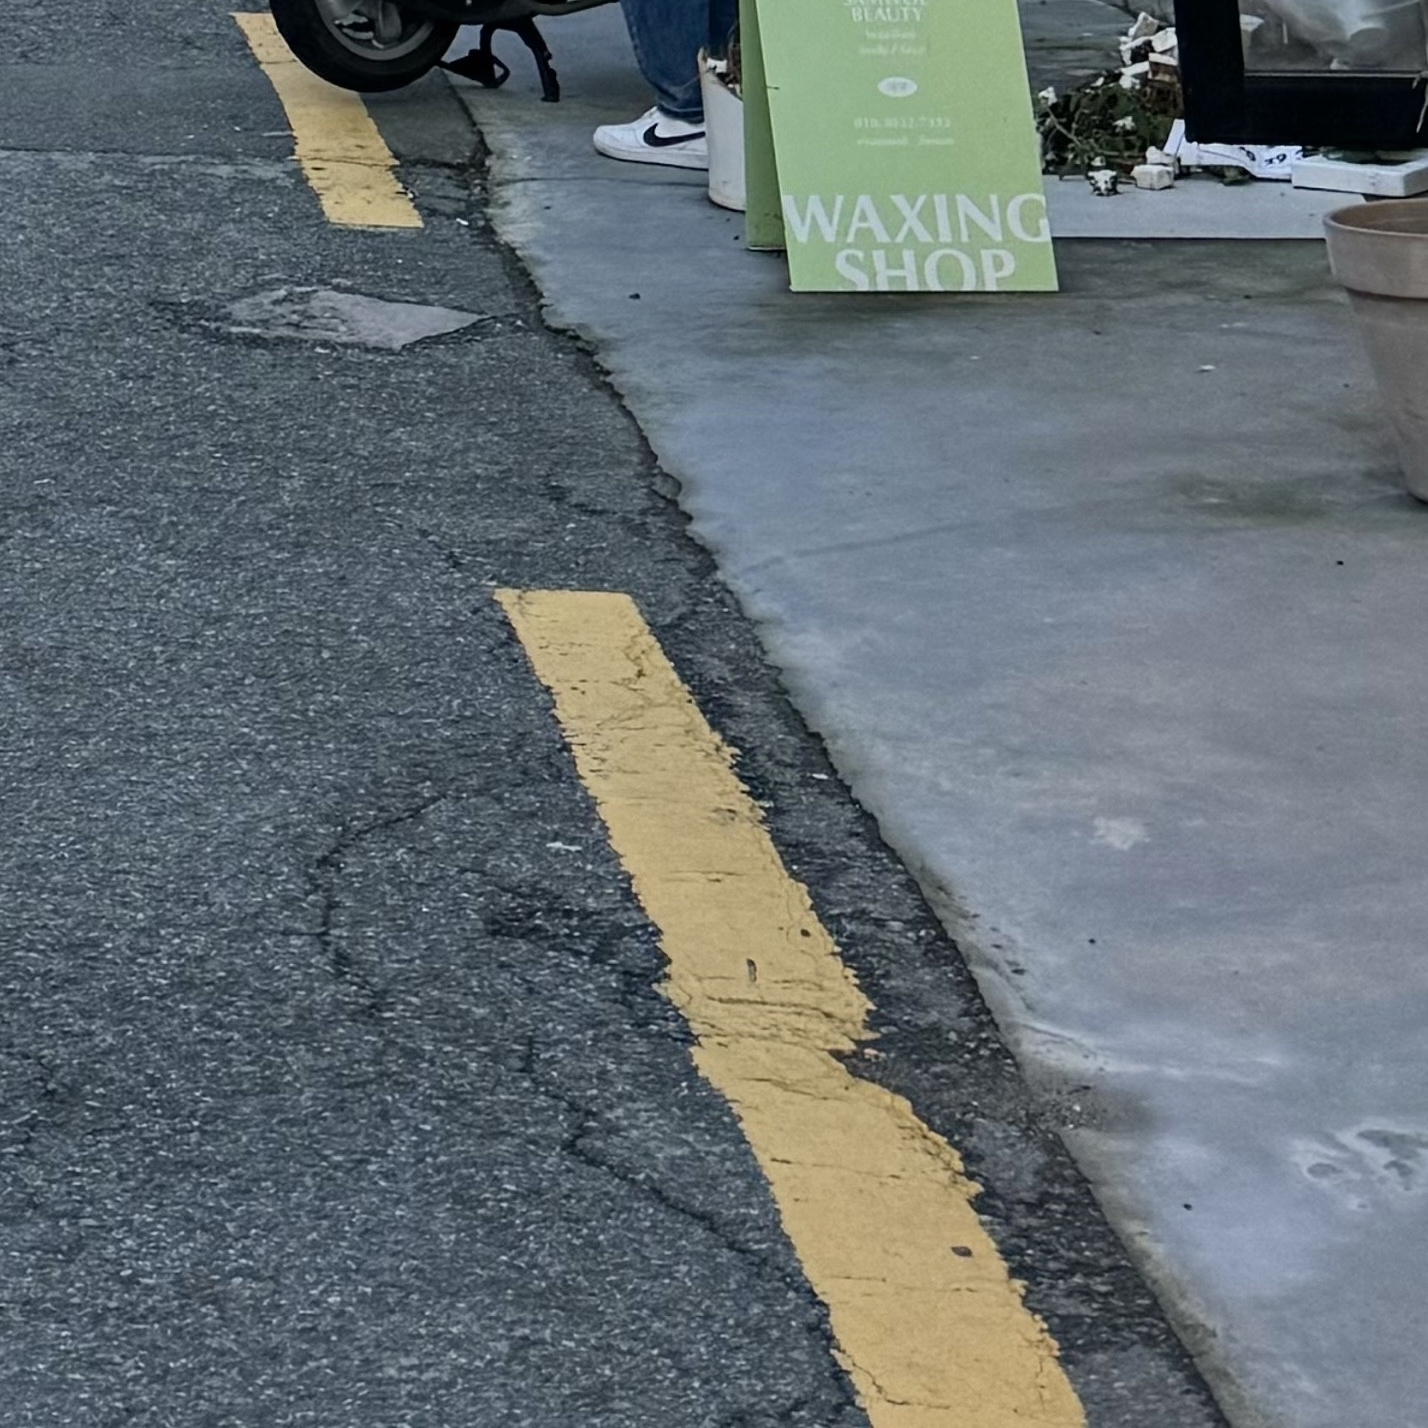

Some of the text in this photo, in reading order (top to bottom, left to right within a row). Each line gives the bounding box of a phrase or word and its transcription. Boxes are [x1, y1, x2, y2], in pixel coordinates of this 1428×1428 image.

[851, 6, 922, 22] BEAUTY
[781, 193, 1051, 243] WAXING
[835, 249, 1016, 291] SHOP
